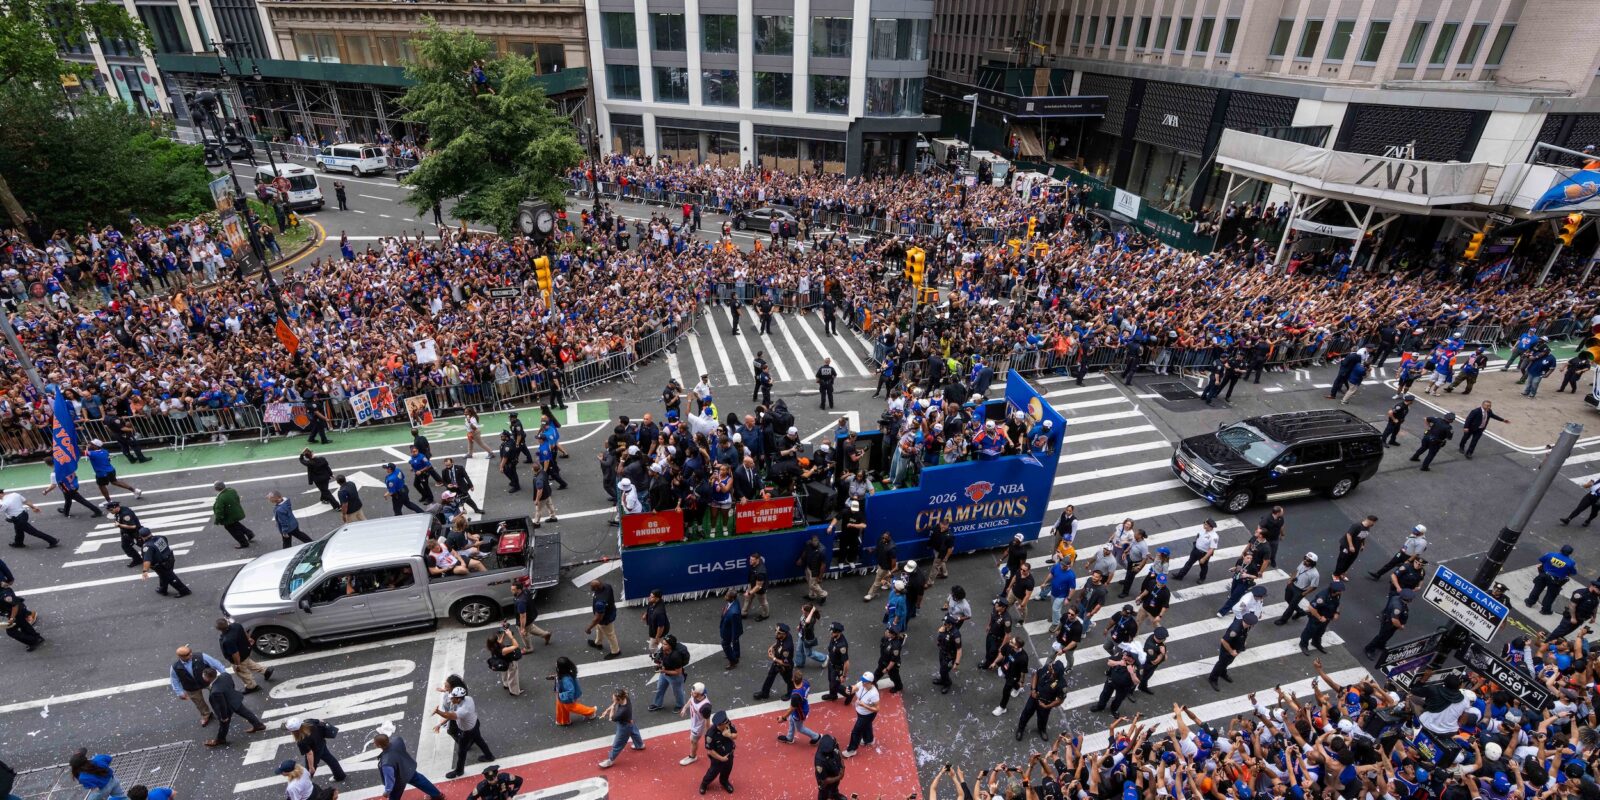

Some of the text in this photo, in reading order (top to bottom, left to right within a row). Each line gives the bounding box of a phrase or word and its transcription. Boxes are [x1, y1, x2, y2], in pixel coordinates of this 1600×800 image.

[1162, 113, 1179, 127] ZARA
[1355, 158, 1428, 195] ZARA
[929, 492, 957, 505] 2026
[998, 483, 1025, 496] NBA
[737, 506, 793, 519] KARL-ANTHONY
[752, 514, 778, 523] TOWNS
[915, 496, 1028, 533] CHAMPIONS
[953, 519, 1009, 532] YORK KNICKS
[687, 558, 747, 575] CHASE
[1438, 580, 1496, 620] BUSES ONLY
[1454, 579, 1502, 614] BUS LANE
[1491, 663, 1544, 701] Vesey ST
